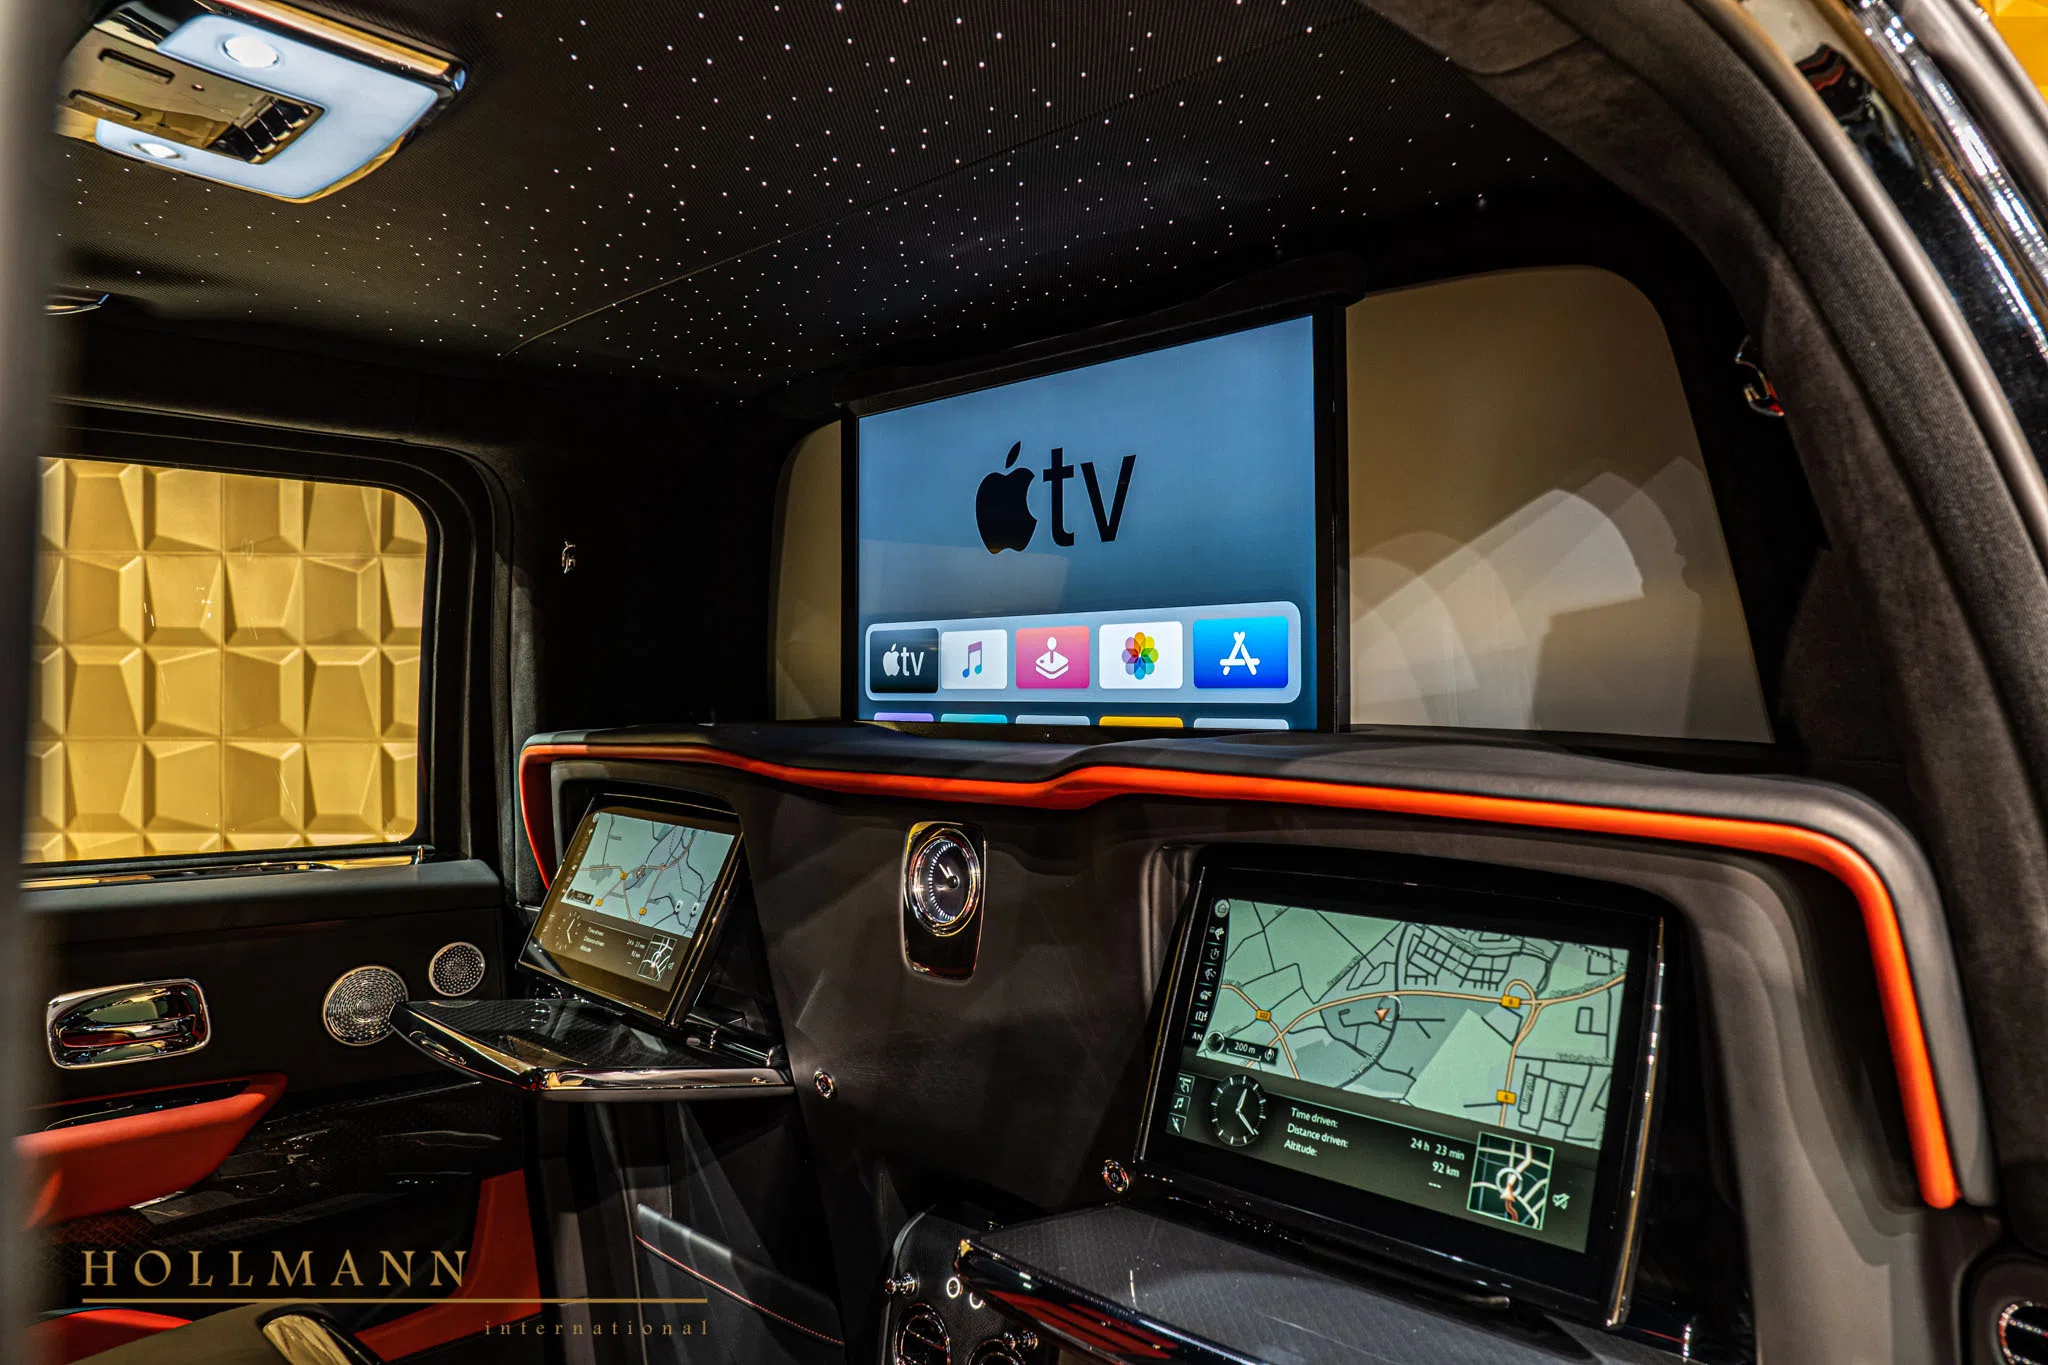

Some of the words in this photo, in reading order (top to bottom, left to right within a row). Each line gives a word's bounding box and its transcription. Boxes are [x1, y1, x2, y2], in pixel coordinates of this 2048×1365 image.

[1042, 447, 1137, 547] tv
[900, 646, 925, 677] tv
[1234, 1041, 1248, 1053] 200
[1248, 1046, 1256, 1054] m
[1291, 1106, 1311, 1122] Time
[1311, 1112, 1339, 1128] driven:
[1287, 1122, 1320, 1141] Distance
[1321, 1131, 1349, 1148] driven:
[1284, 1139, 1318, 1157] Altitude:
[1410, 1137, 1422, 1150] 24
[1423, 1140, 1430, 1152] h
[1434, 1143, 1448, 1156] 23
[1448, 1148, 1465, 1161] min
[1432, 1160, 1444, 1174] 92
[1445, 1165, 1460, 1178] km
